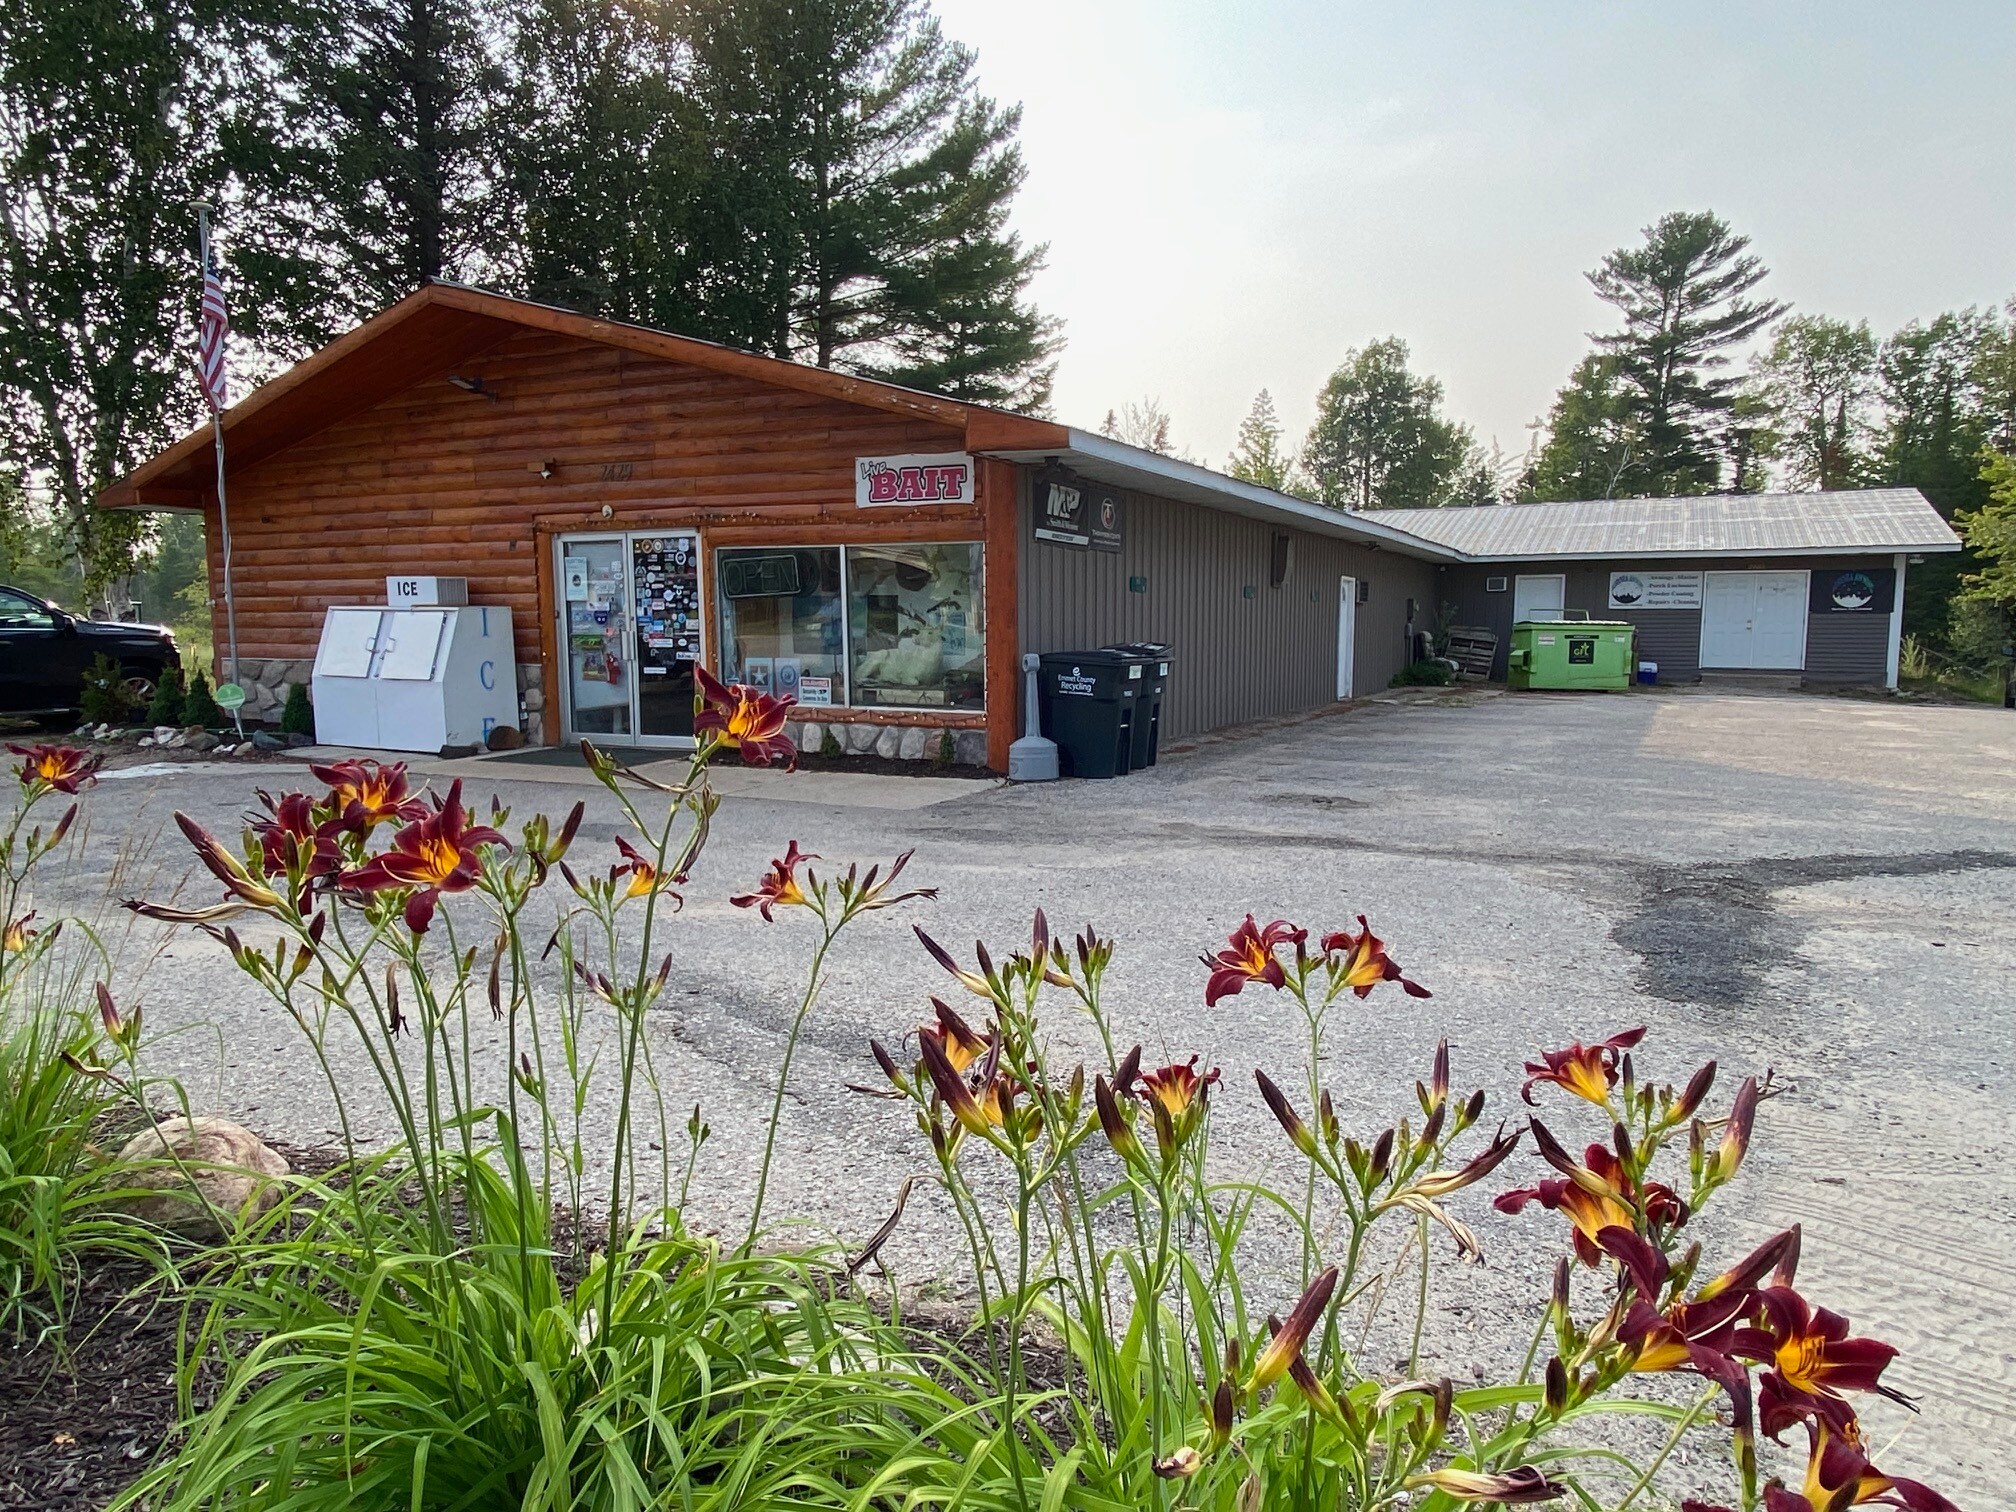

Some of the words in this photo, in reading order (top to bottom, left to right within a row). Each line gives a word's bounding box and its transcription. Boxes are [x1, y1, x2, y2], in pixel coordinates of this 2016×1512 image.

[860, 461, 887, 480] Live
[869, 464, 967, 503] BAIT
[725, 560, 795, 593] OPEN
[397, 581, 418, 596] ICE
[1057, 674, 1076, 683] Emmet
[1076, 675, 1096, 685] County
[1060, 681, 1092, 693] Recycling
